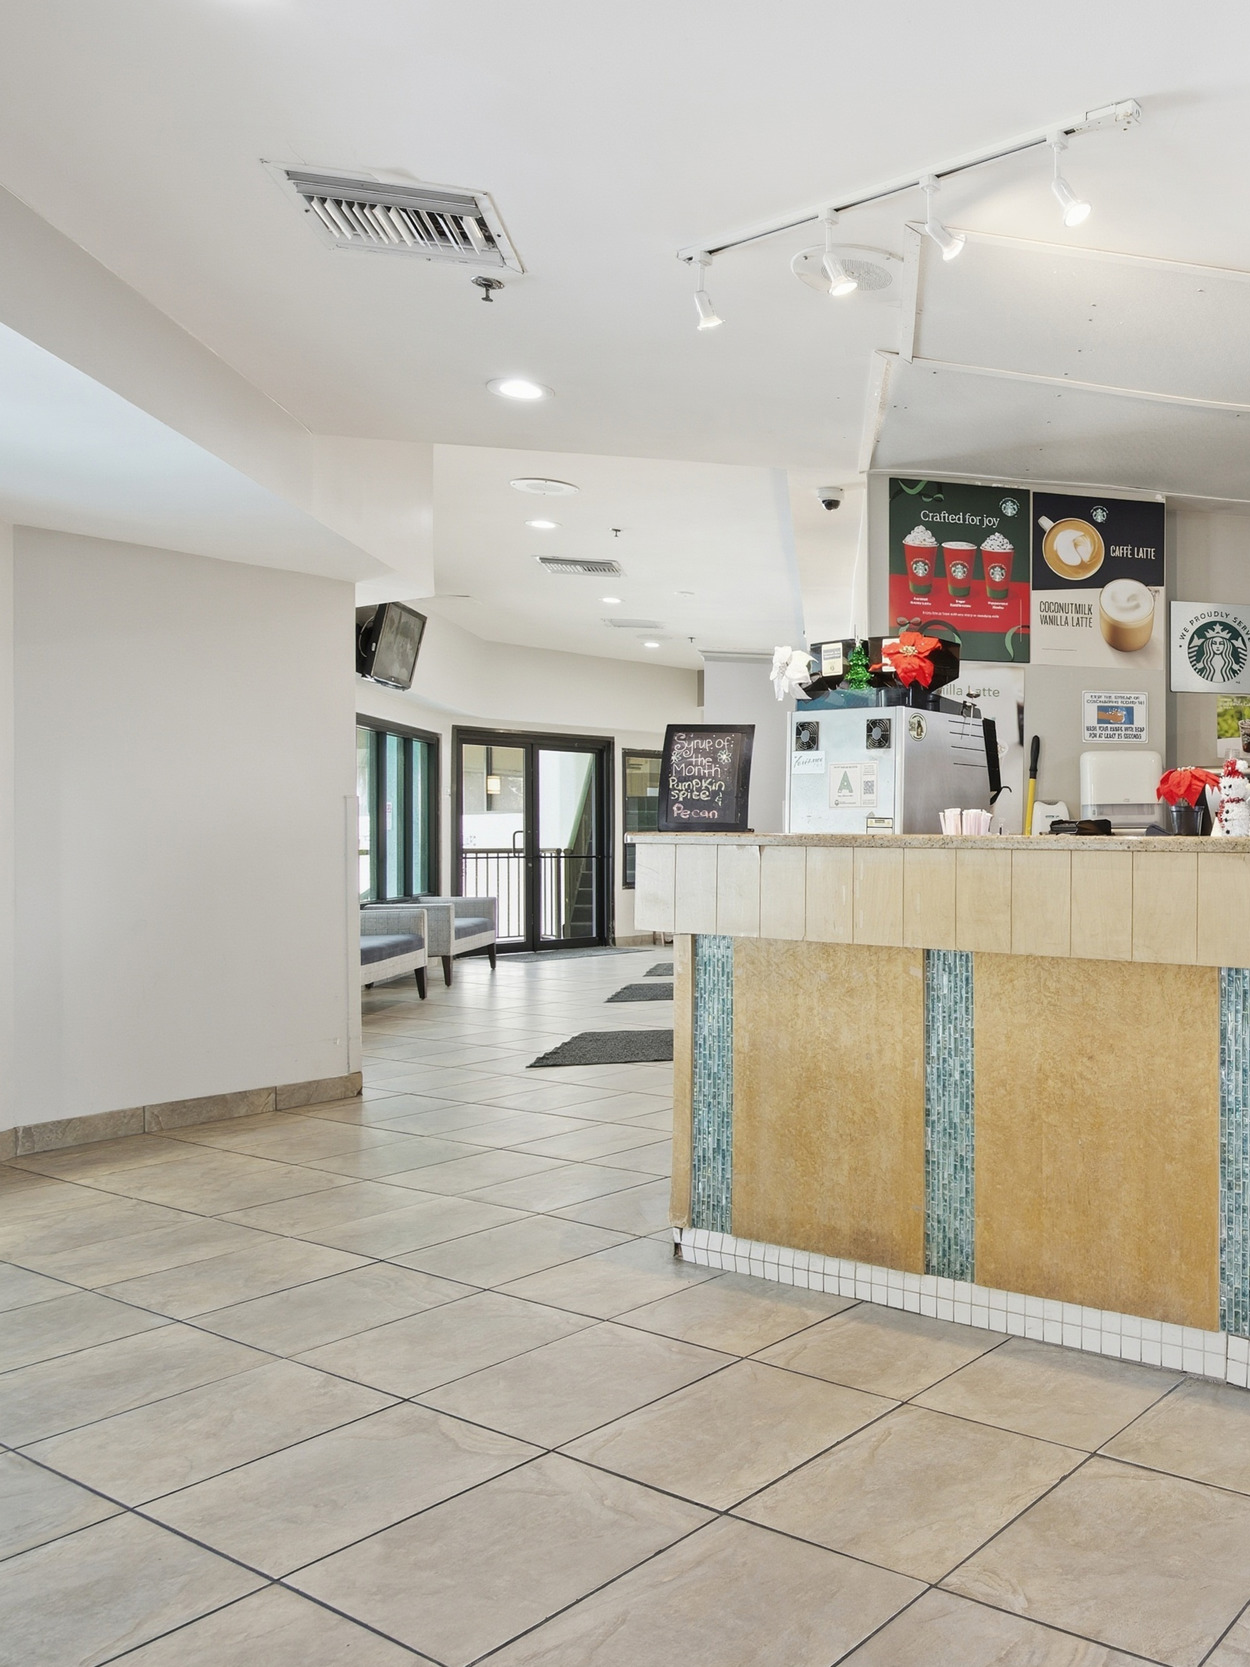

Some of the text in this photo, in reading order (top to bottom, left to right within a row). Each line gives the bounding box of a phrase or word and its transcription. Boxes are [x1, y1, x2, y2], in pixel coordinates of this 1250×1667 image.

[920, 510, 1000, 528] Crafted for joy
[1110, 544, 1156, 560] CAFFÈ LATTE
[1040, 601, 1093, 615] COCONUTMILK
[1040, 614, 1093, 628] VANILLA LATTE
[1179, 627, 1190, 641] WE
[1189, 611, 1230, 626] PROUDLY
[674, 733, 731, 757] Syrup of
[687, 754, 713, 766] the
[673, 763, 720, 777] Month
[669, 777, 725, 791] Pumpkin
[837, 770, 853, 793] A
[670, 790, 711, 801] spice
[673, 803, 718, 818] Pecan
